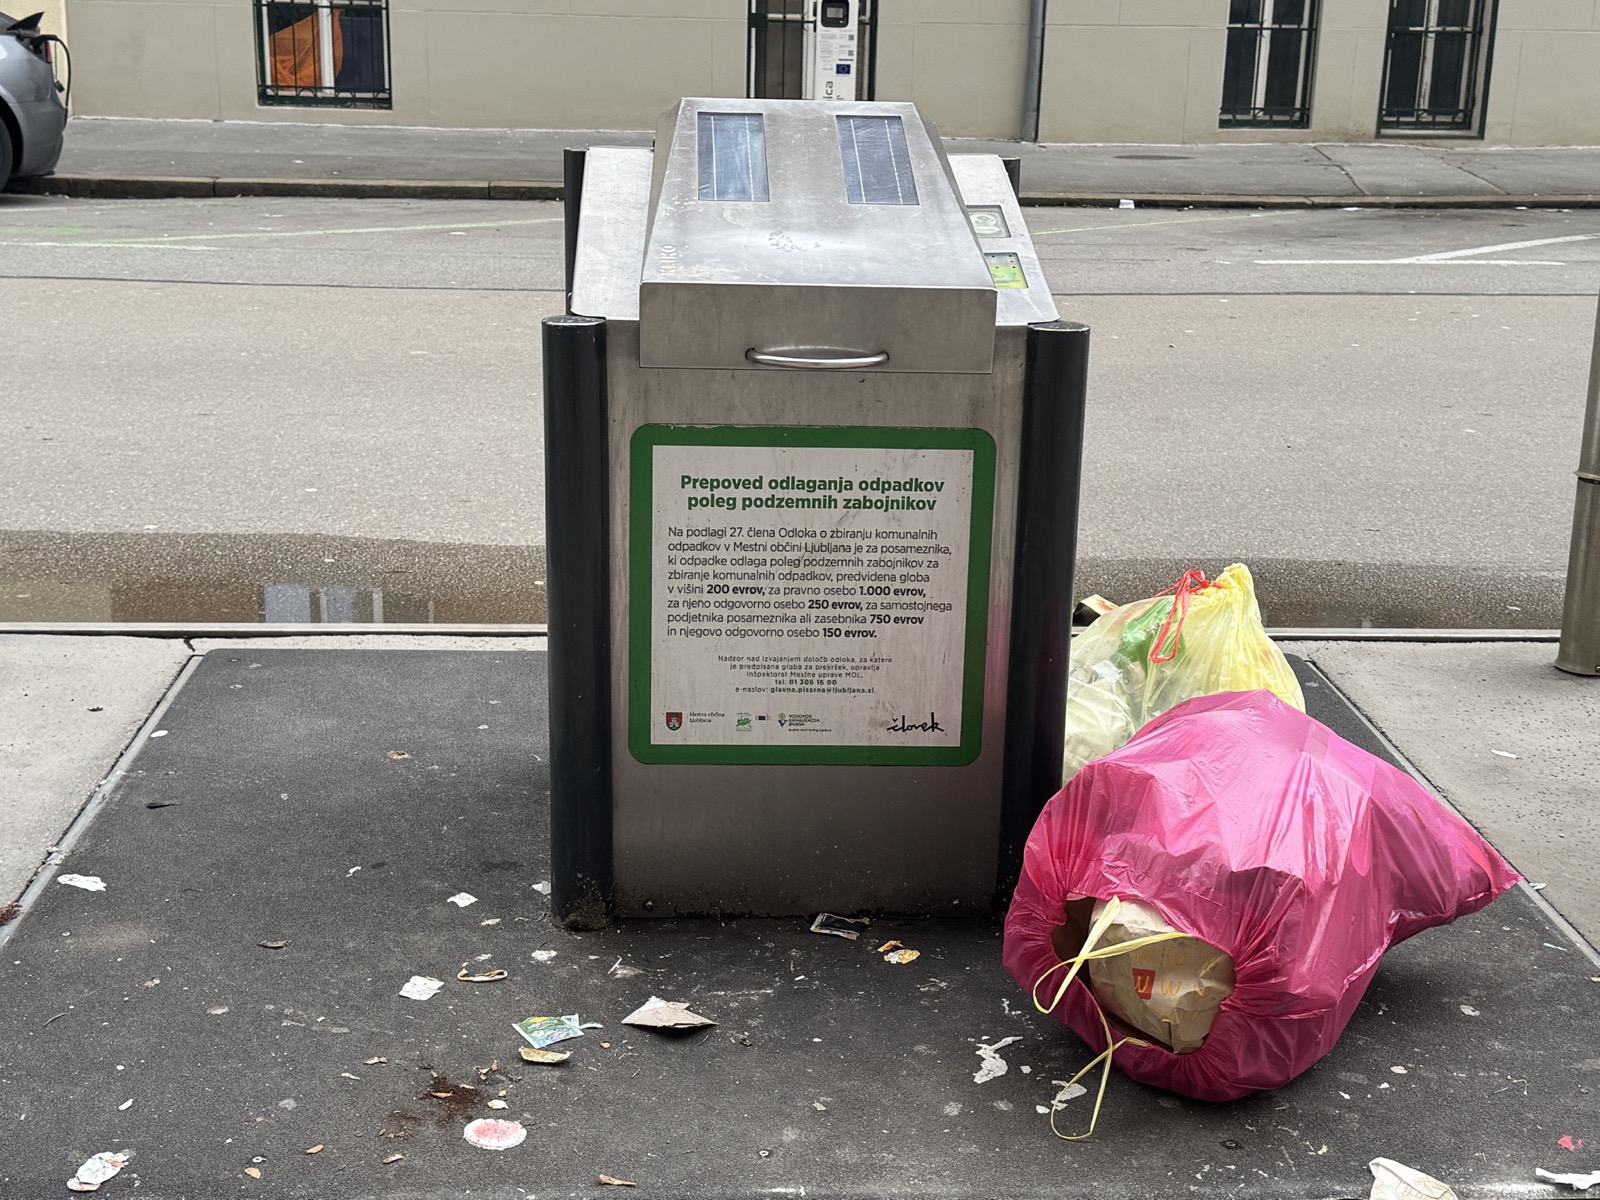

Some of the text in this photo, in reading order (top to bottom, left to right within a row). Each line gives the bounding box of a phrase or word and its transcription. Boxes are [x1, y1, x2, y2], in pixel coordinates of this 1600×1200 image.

[680, 475, 944, 496] Prepoved odlaganja odpadkov
[688, 493, 937, 514] poleg podzemnih zabojnikov
[668, 526, 937, 543] Na podlagi 27. člena Odloka o zbiranju komunalnih
[668, 540, 952, 558] odpadkov v Mestni občini Ljubljana je za posameznika,
[668, 554, 938, 572] ki odpadke odlaga poleg podzemnih zabojnikov za
[668, 568, 929, 586] zbiranje komunalnih odpadkov, predvidena globa
[668, 583, 926, 599] v višini 200 evrov, za pravno osebo 1.000 evrov,
[668, 597, 952, 614] za njeno odgovorno osebo 250 evrov, za samostojnega
[668, 611, 924, 626] podjetnika posameznika ali zasebnika 750 evrov
[668, 625, 877, 640] in njegovo odgovorno osebo 150 evrov.
[730, 663, 737, 671] je
[782, 663, 802, 672] globa
[851, 664, 880, 673] opravlja
[830, 656, 856, 664] odloka,
[735, 685, 768, 693] e-naslov:
[886, 712, 944, 732] človek
